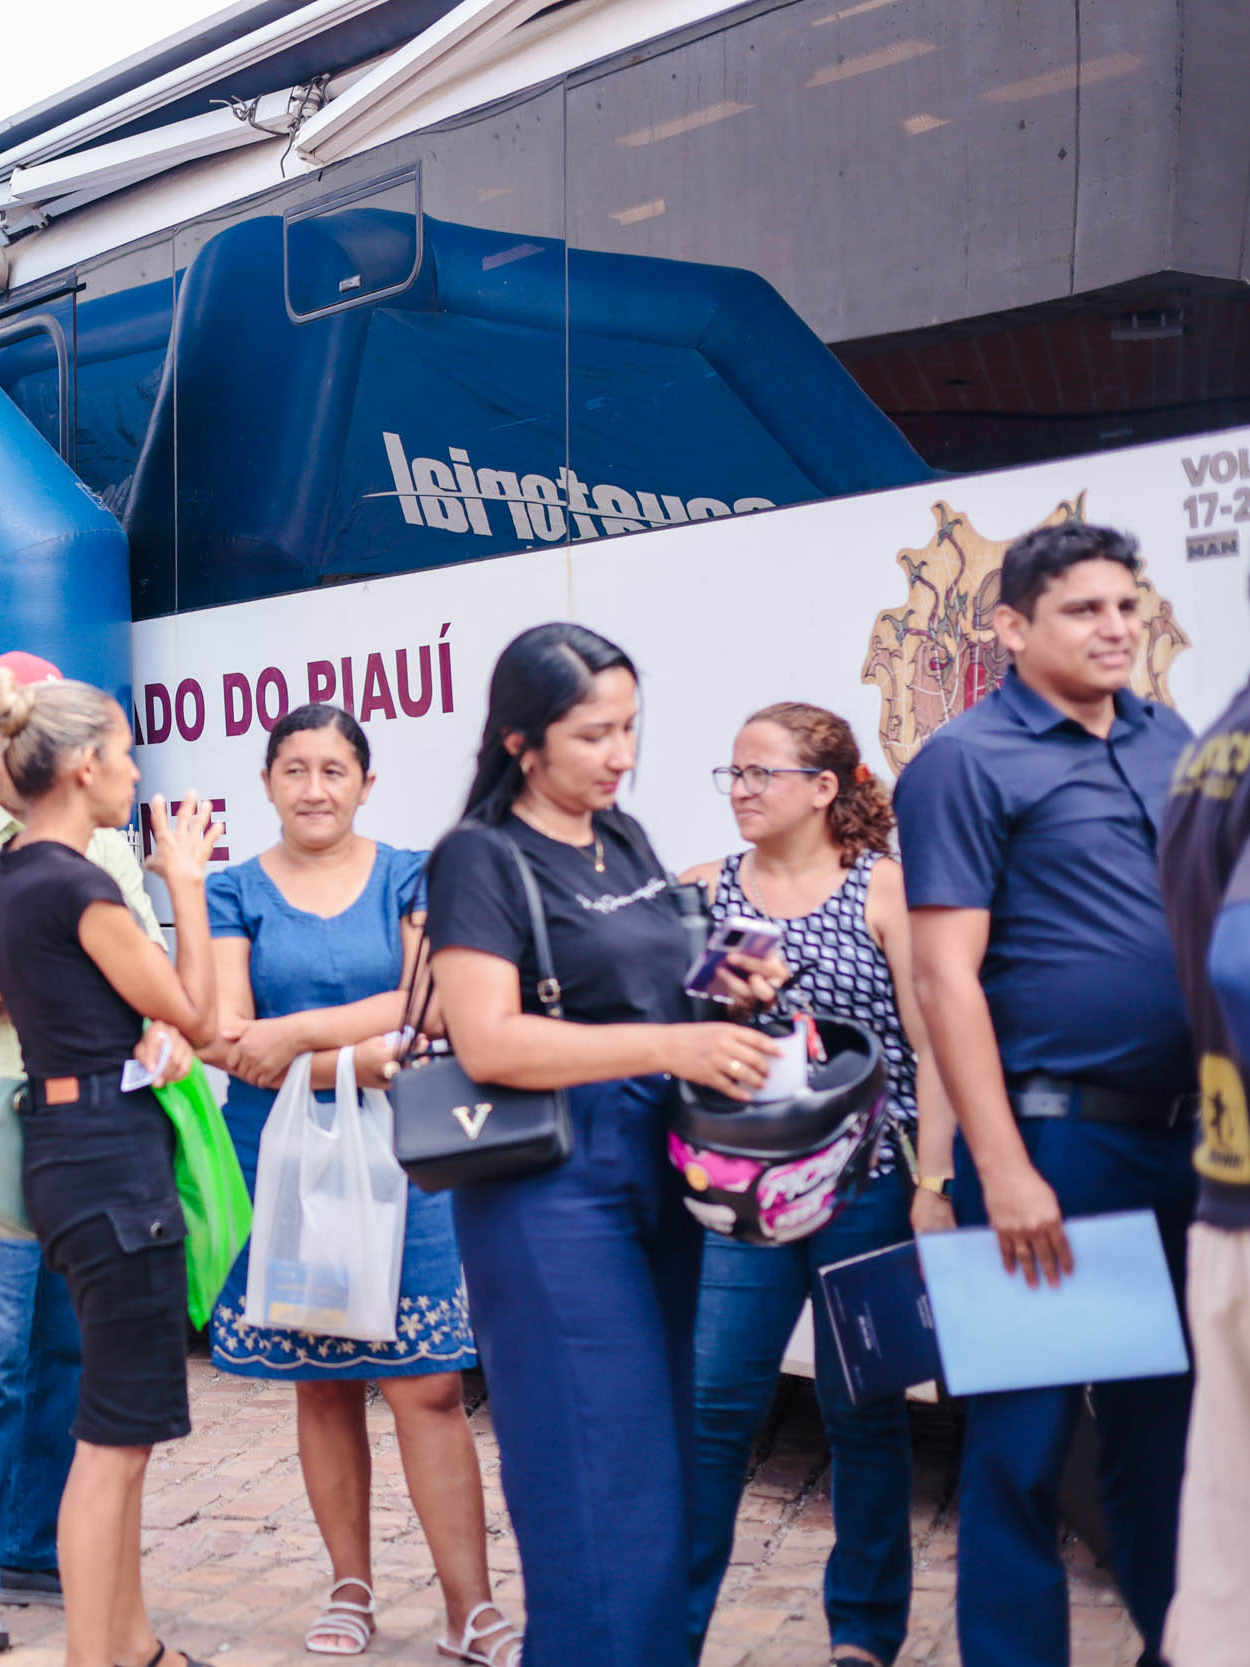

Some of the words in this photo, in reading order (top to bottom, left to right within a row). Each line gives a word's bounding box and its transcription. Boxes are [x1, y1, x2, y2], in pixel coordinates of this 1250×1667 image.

[1181, 448, 1250, 488] VOL
[1183, 486, 1250, 529] 17-2
[1187, 540, 1238, 559] MAN
[223, 666, 289, 737] DO
[307, 622, 454, 723] PIAUÍ
[453, 1103, 492, 1140] V
